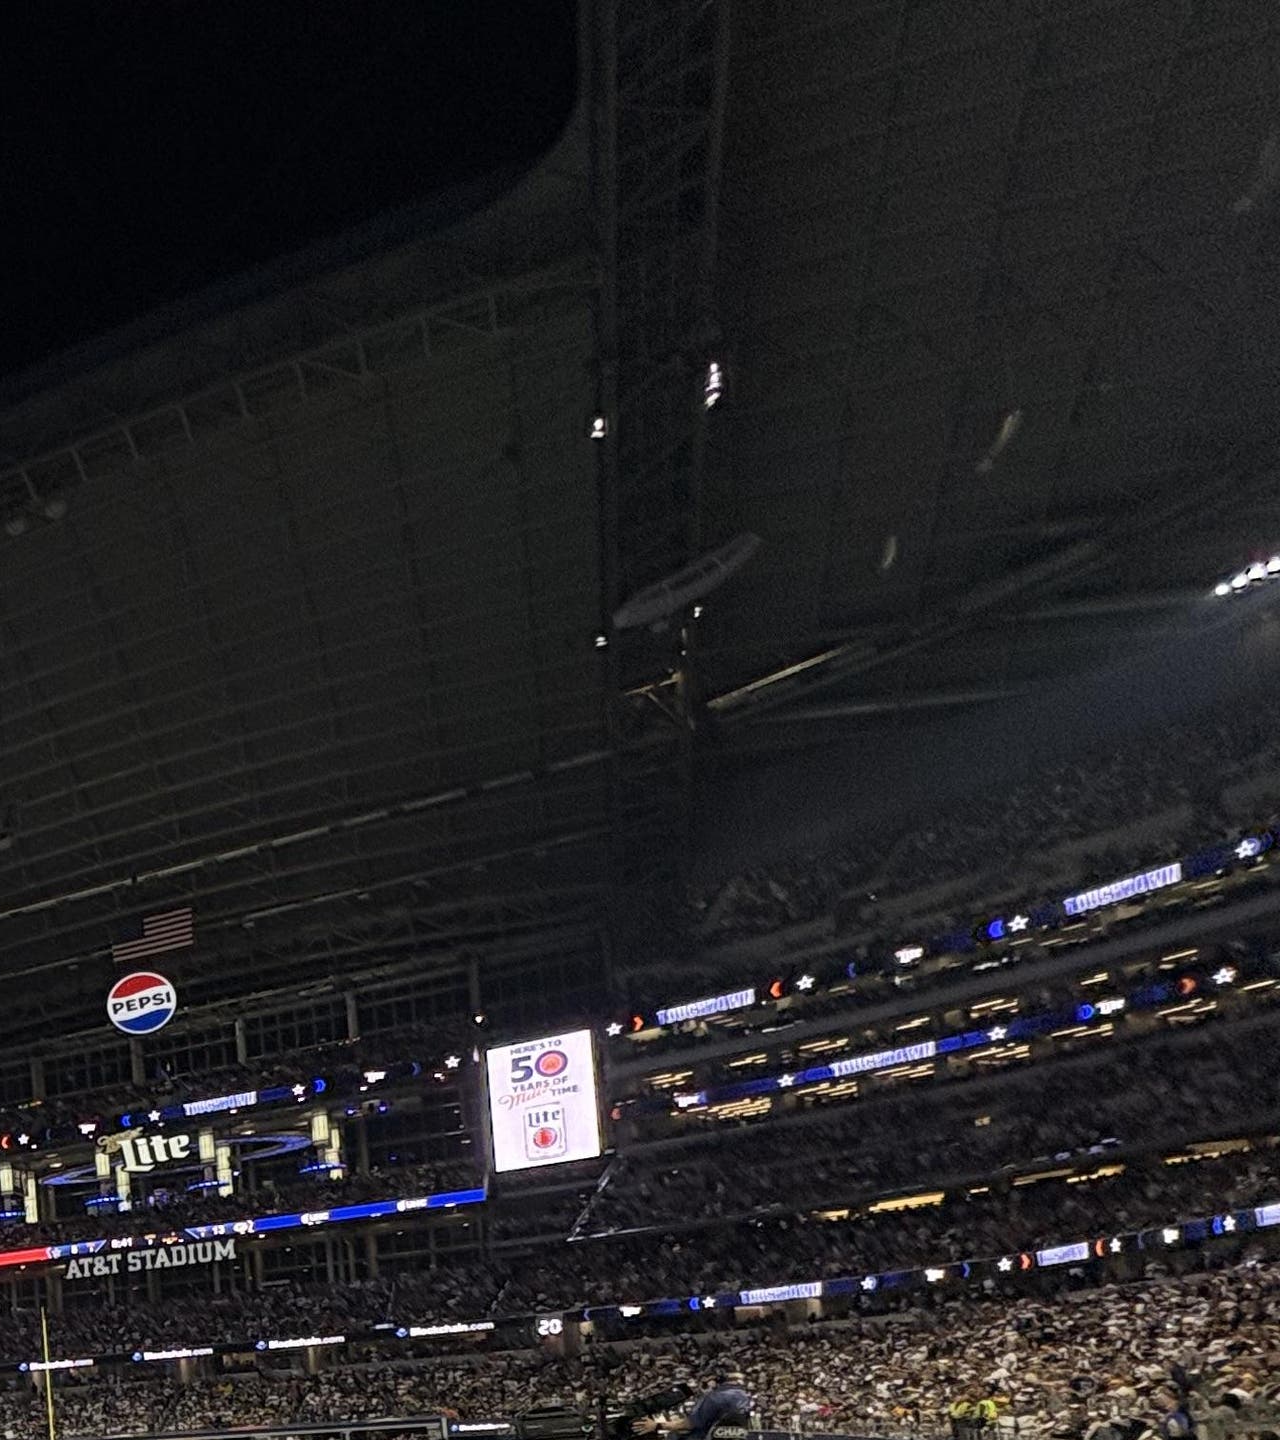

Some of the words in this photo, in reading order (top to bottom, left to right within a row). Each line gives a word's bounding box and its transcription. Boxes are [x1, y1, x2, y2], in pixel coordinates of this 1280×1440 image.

[112, 992, 171, 1015] PEPSI
[510, 1050, 569, 1083] 50
[512, 1080, 551, 1094] YEARS
[553, 1076, 569, 1086] OF
[550, 1085, 580, 1097] TIME
[528, 1110, 561, 1128] Lite
[118, 1134, 190, 1173] Lite
[66, 1252, 122, 1280] AT&T
[127, 1239, 237, 1273] STADIUM
[537, 1318, 563, 1336] 20
